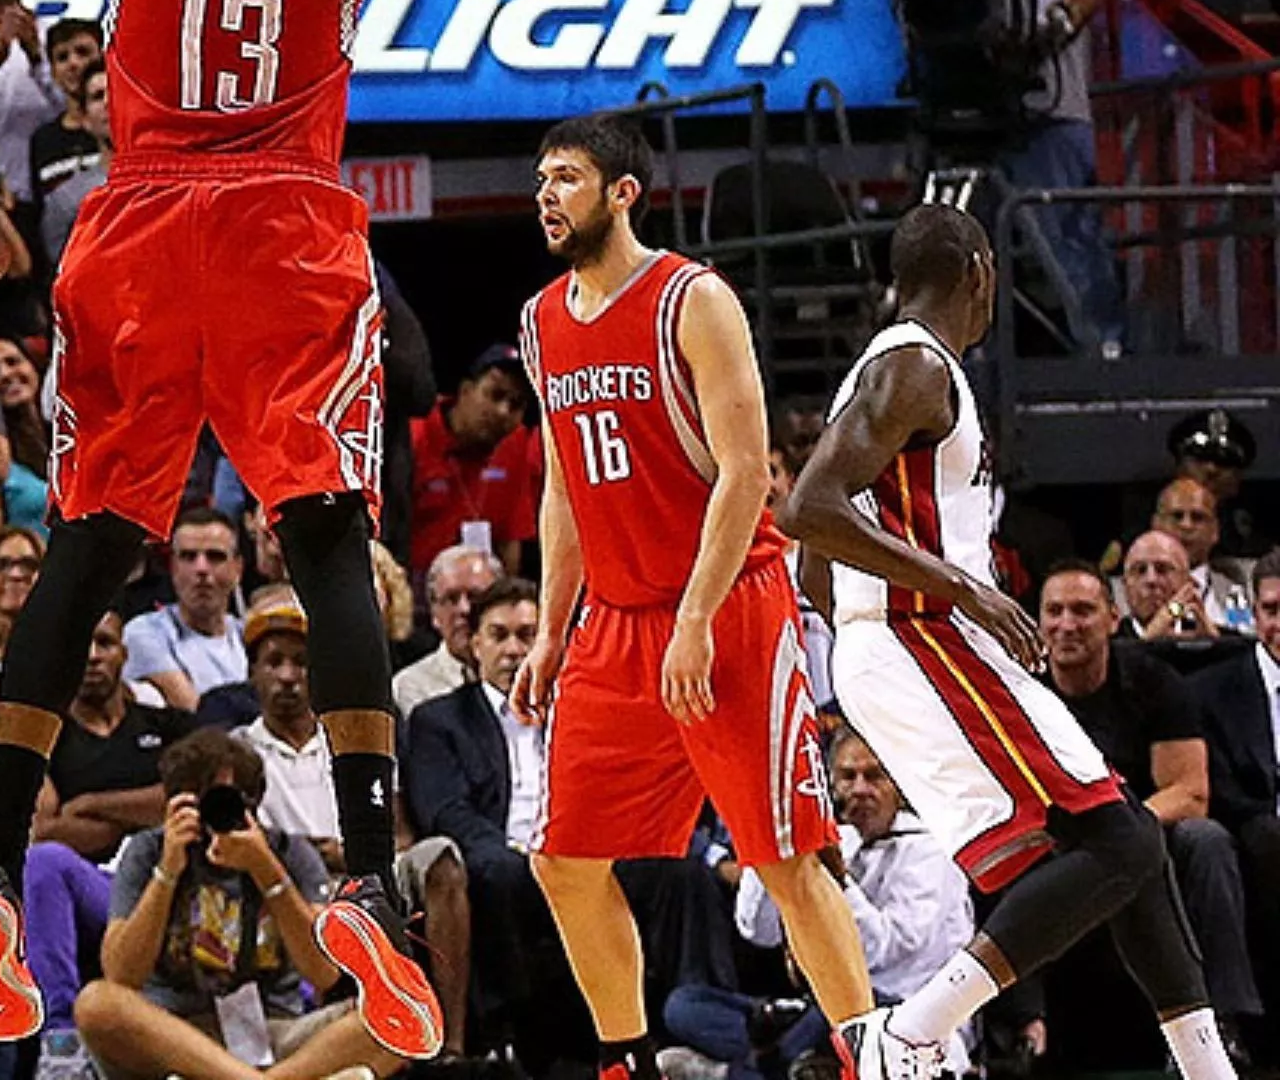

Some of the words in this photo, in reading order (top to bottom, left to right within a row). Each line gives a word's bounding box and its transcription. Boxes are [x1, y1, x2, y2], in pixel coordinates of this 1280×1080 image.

[350, 160, 417, 213] EXIT
[546, 365, 652, 413] ROCKETS
[574, 410, 631, 484] 16
